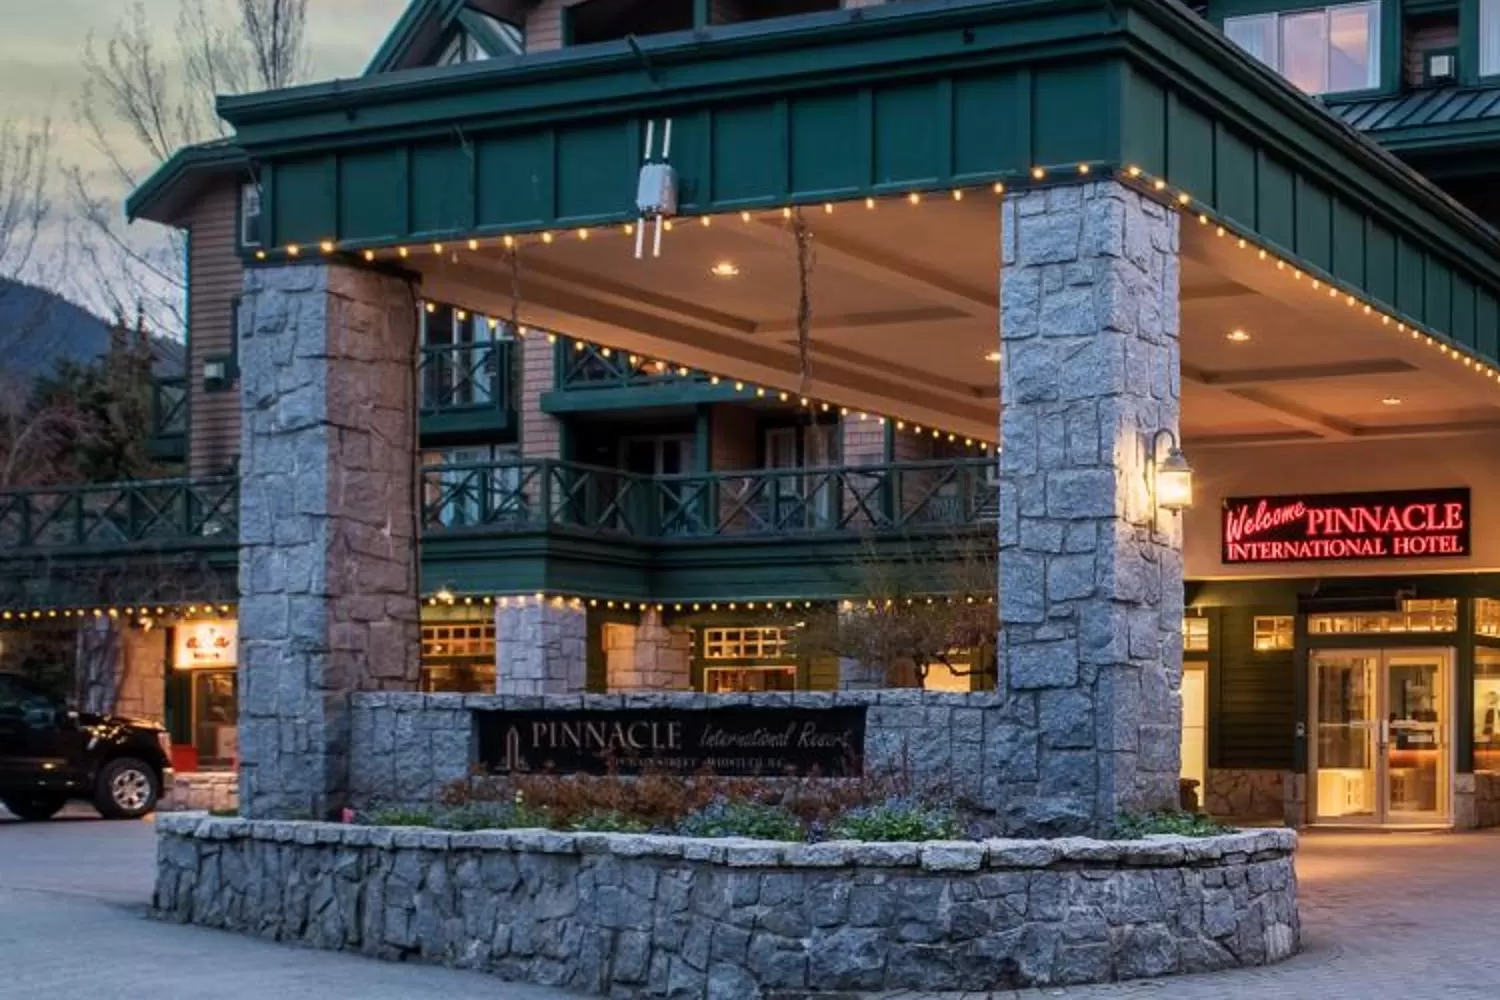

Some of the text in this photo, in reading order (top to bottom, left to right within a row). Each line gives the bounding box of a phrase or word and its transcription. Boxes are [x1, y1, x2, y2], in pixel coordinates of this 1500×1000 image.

[1226, 500, 1463, 542] Welcome PINNACLE
[1227, 535, 1463, 560] INTERNATIONAL HOTEL
[532, 720, 682, 750] PINNACLE
[699, 719, 798, 748] International
